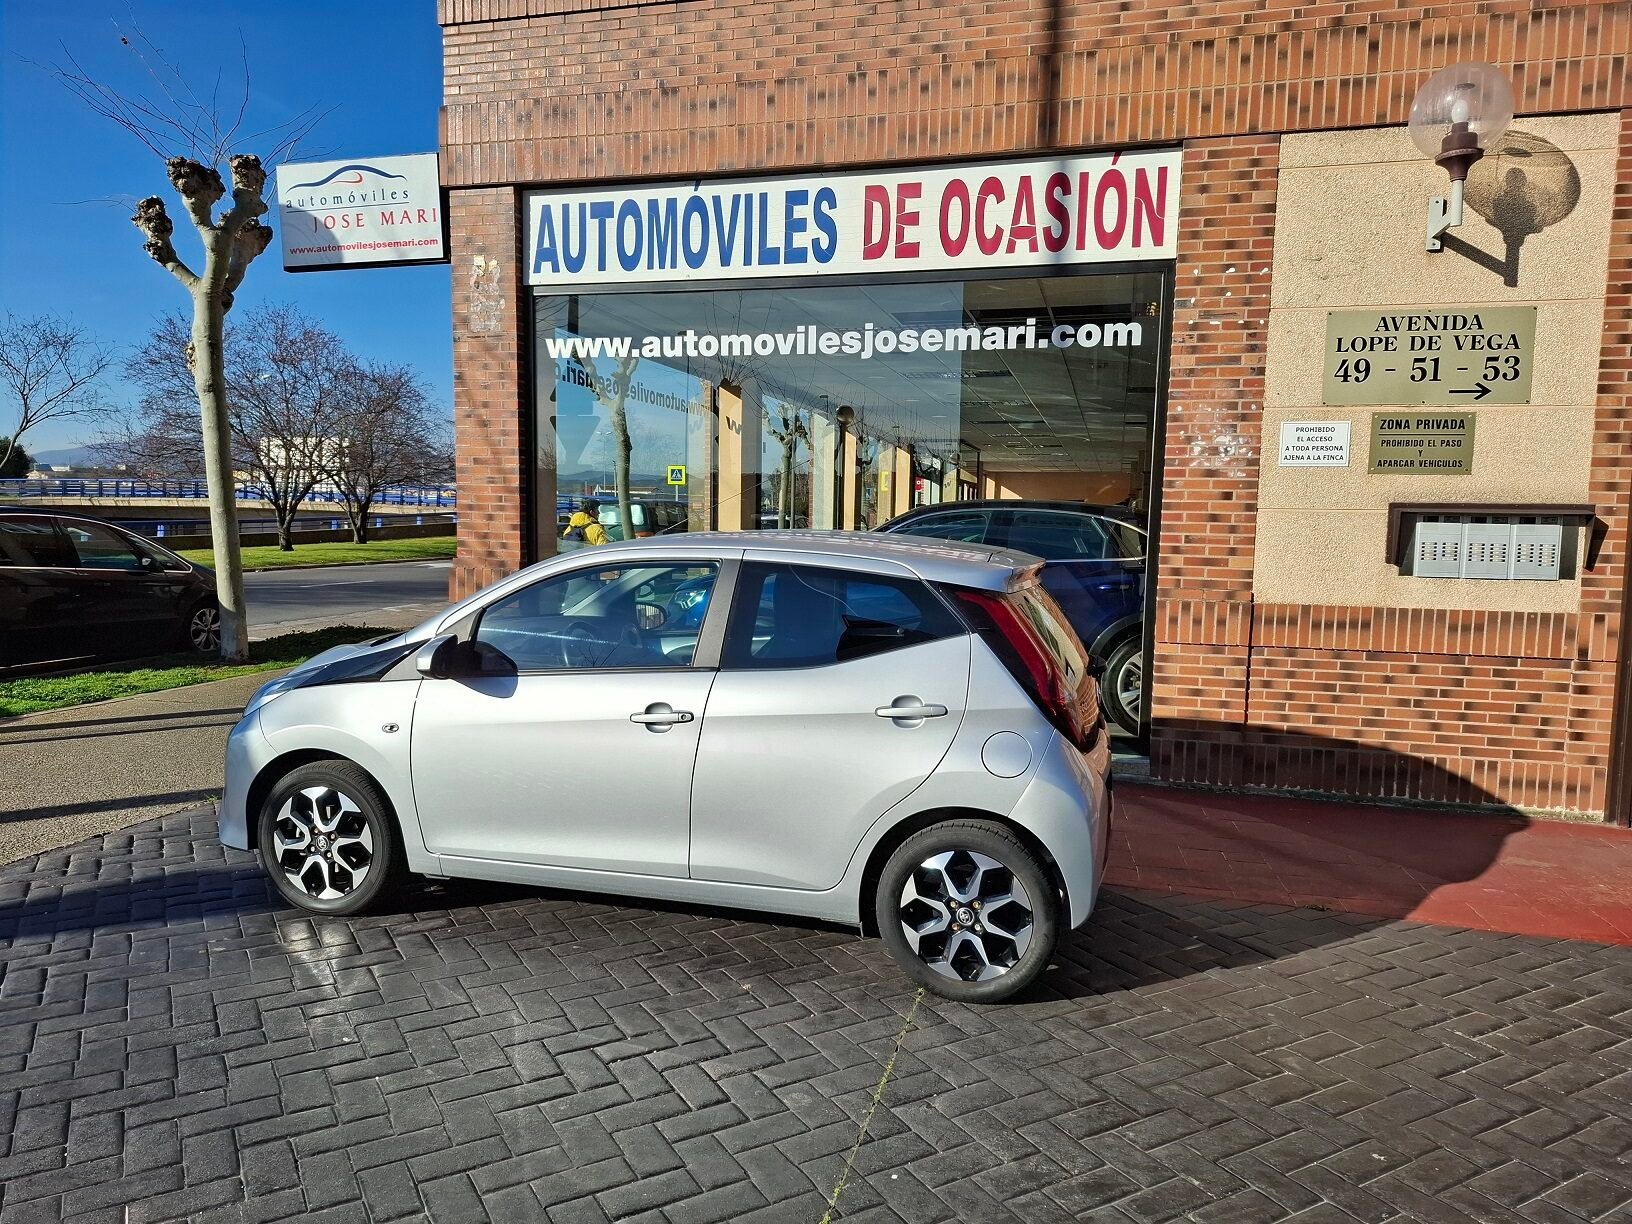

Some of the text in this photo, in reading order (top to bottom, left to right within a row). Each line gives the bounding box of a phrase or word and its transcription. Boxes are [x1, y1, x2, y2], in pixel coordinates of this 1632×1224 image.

[286, 188, 409, 208] automóviles
[313, 207, 437, 233] JOSE MARI
[533, 151, 1169, 274] AUTOMÓVILES DE OCASIÓN
[289, 238, 439, 255] www.automovilesjosemari.com
[1374, 314, 1485, 332] AVENIDA
[545, 317, 1143, 359] www.automovilesjosemari.com
[1335, 333, 1521, 353] LOPE DE VEGA
[1334, 358, 1371, 383] 49
[1409, 356, 1442, 382] 51
[1482, 354, 1521, 382] 53
[1379, 418, 1466, 430] ZONA PRIVADA
[1380, 439, 1462, 447] PROHIBIDO EL PASO
[1418, 449, 1423, 457] Y
[1376, 459, 1463, 468] APARCAR VEHICULOS
